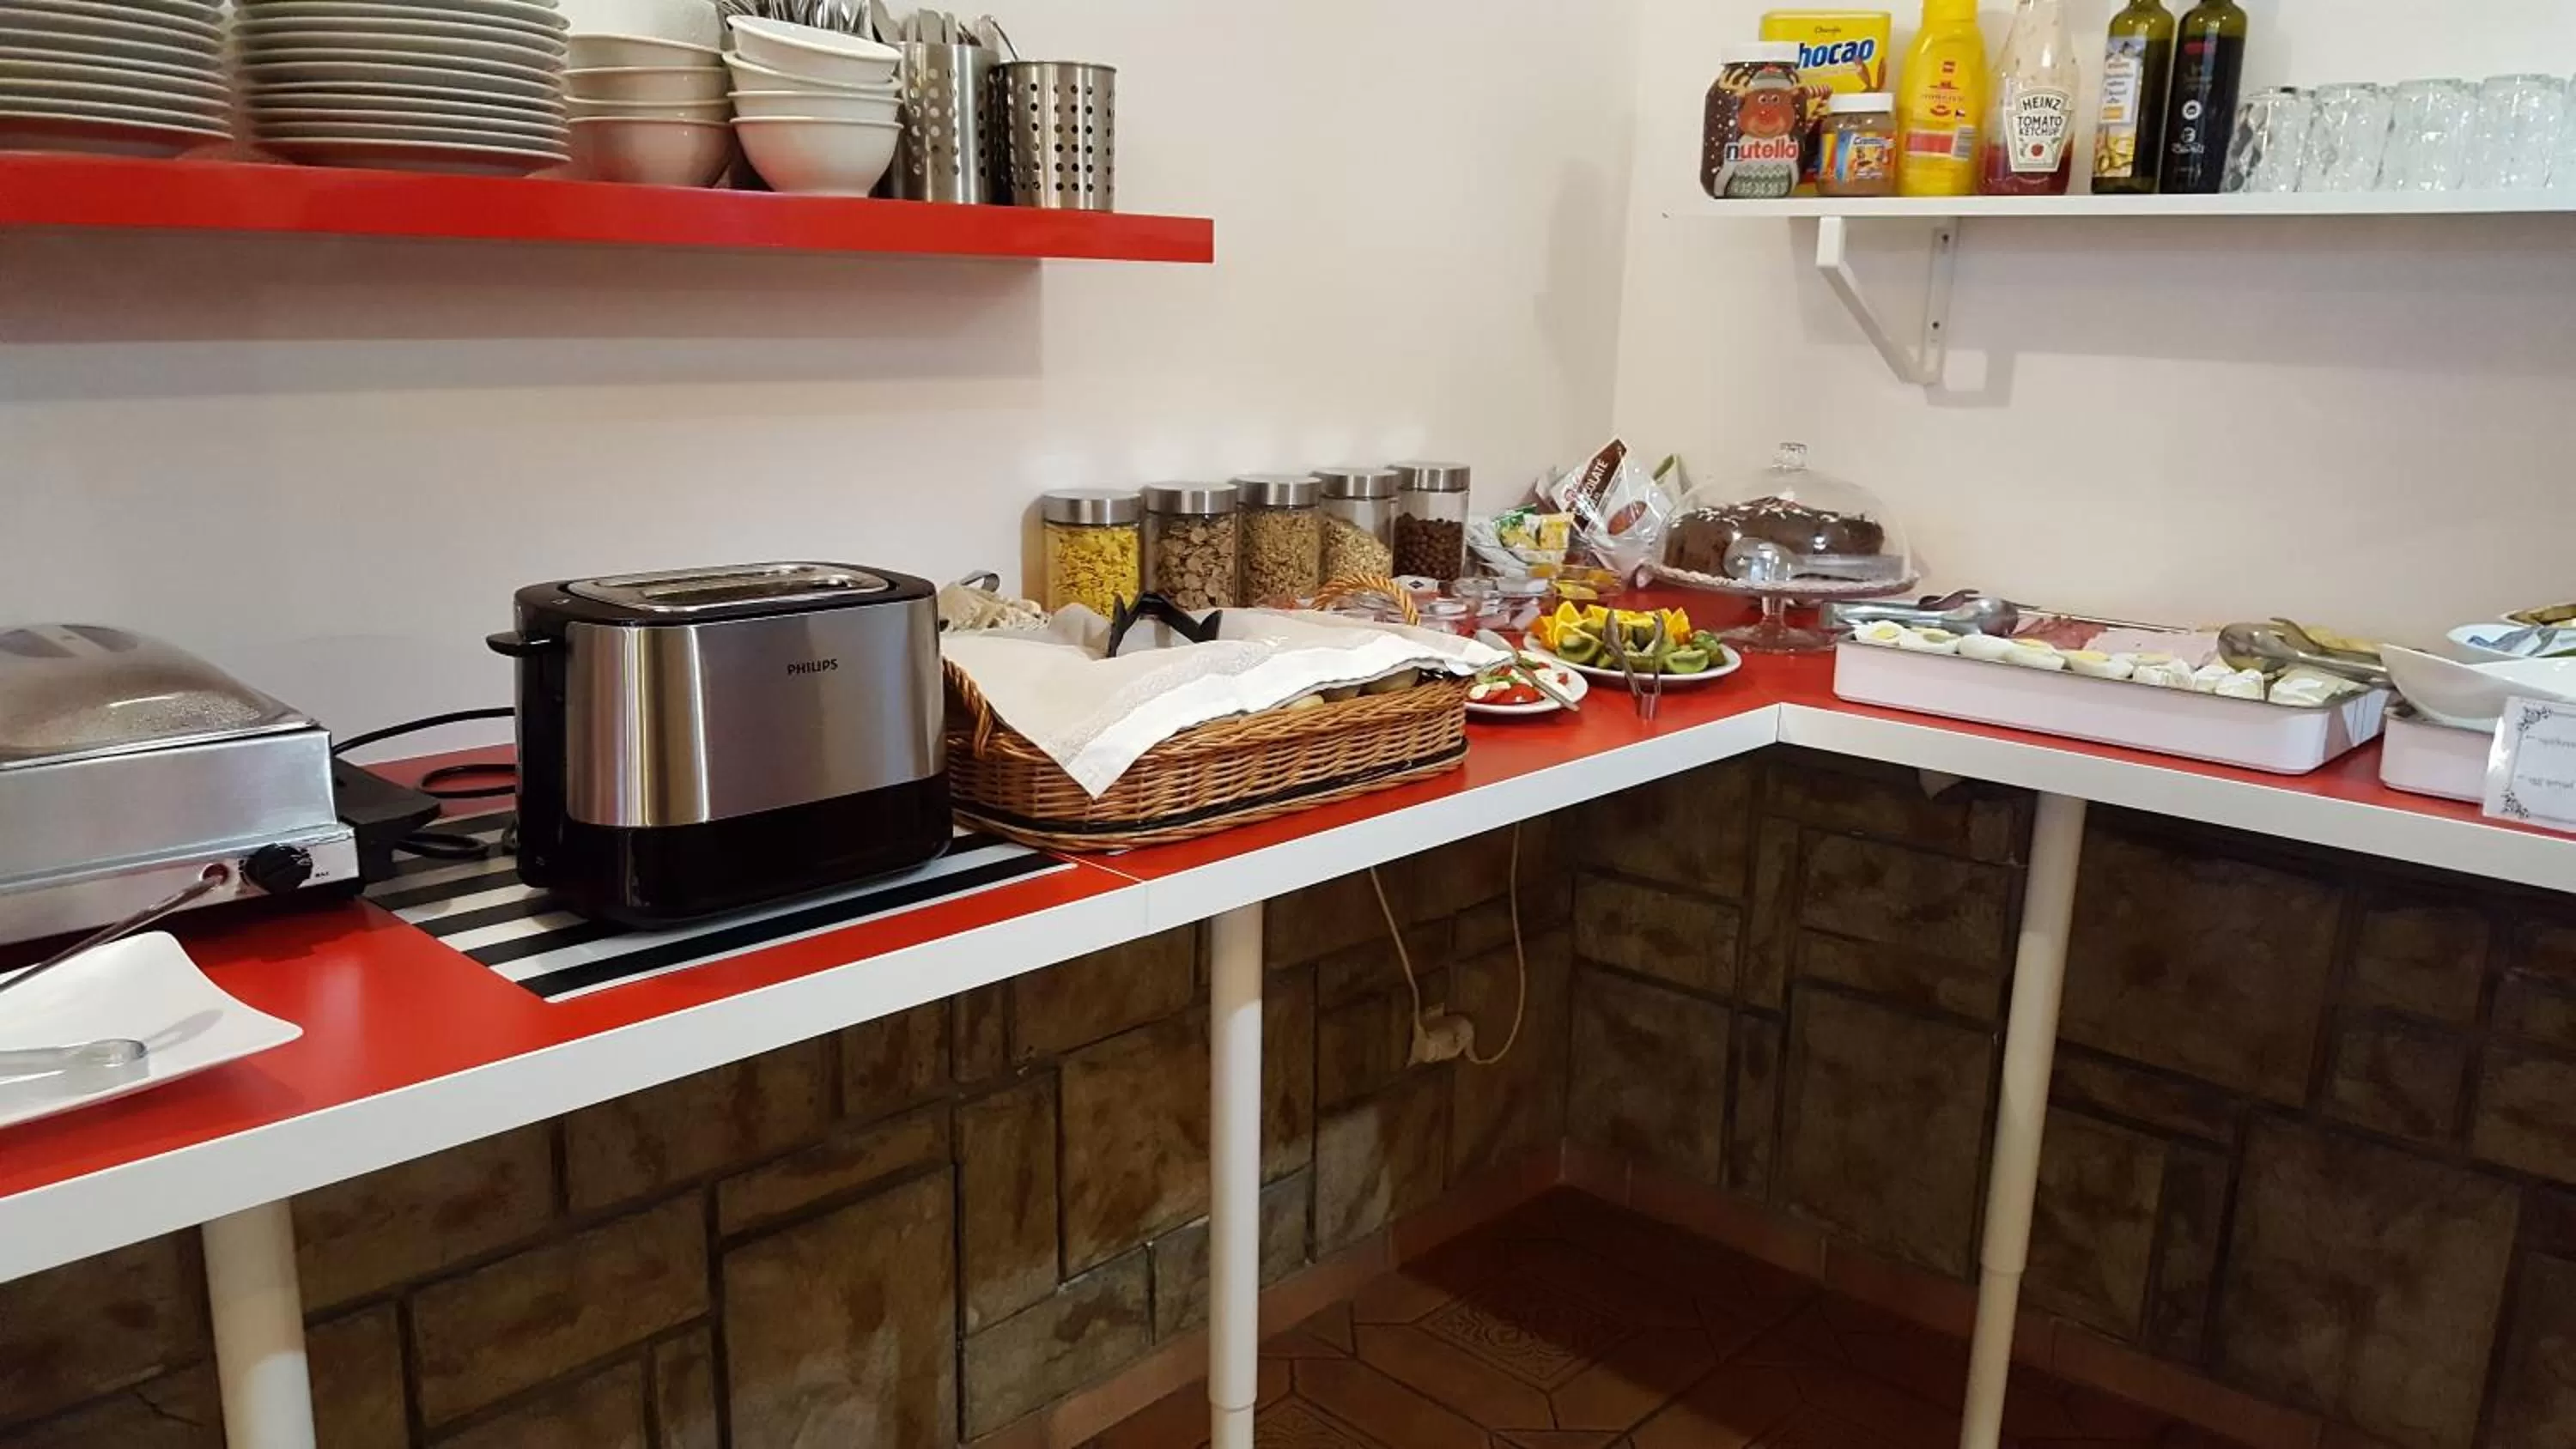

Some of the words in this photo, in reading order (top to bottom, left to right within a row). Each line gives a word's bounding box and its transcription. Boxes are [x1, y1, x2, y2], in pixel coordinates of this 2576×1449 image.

[1798, 39, 1874, 69] hocao
[2022, 96, 2062, 111] HEINZ
[2018, 116, 2063, 129] TOMATO
[2019, 127, 2061, 136] KETCHUP
[1726, 138, 1798, 161] nutella
[787, 658, 839, 676] PHILIPS
